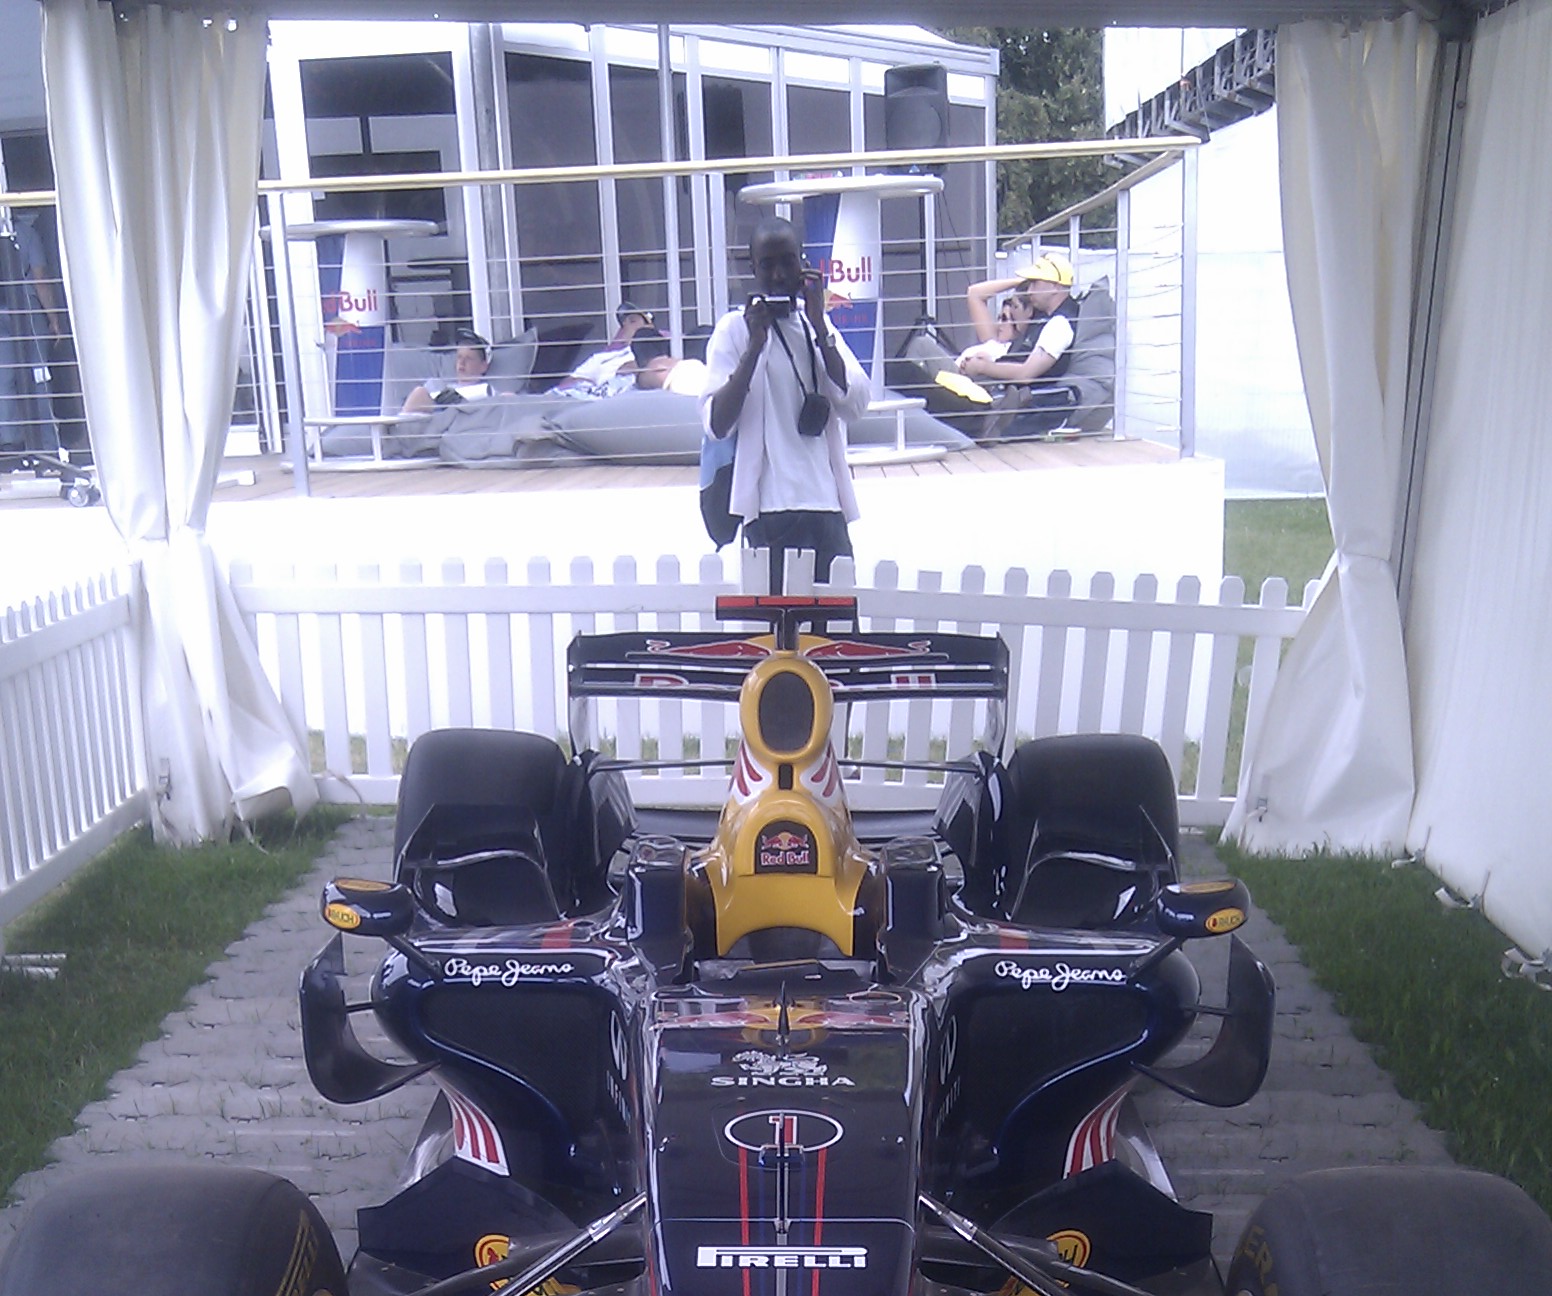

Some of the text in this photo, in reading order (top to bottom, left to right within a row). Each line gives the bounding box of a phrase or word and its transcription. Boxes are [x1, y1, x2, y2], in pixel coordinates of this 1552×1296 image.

[829, 256, 872, 283] Bull
[338, 289, 378, 312] Bull
[760, 850, 810, 866] Red Bull
[444, 958, 574, 986] Pepe Jeans
[995, 960, 1126, 991] Pepe Jeans
[710, 1076, 856, 1087] SINGHA
[697, 1246, 868, 1268] PIRELLI
